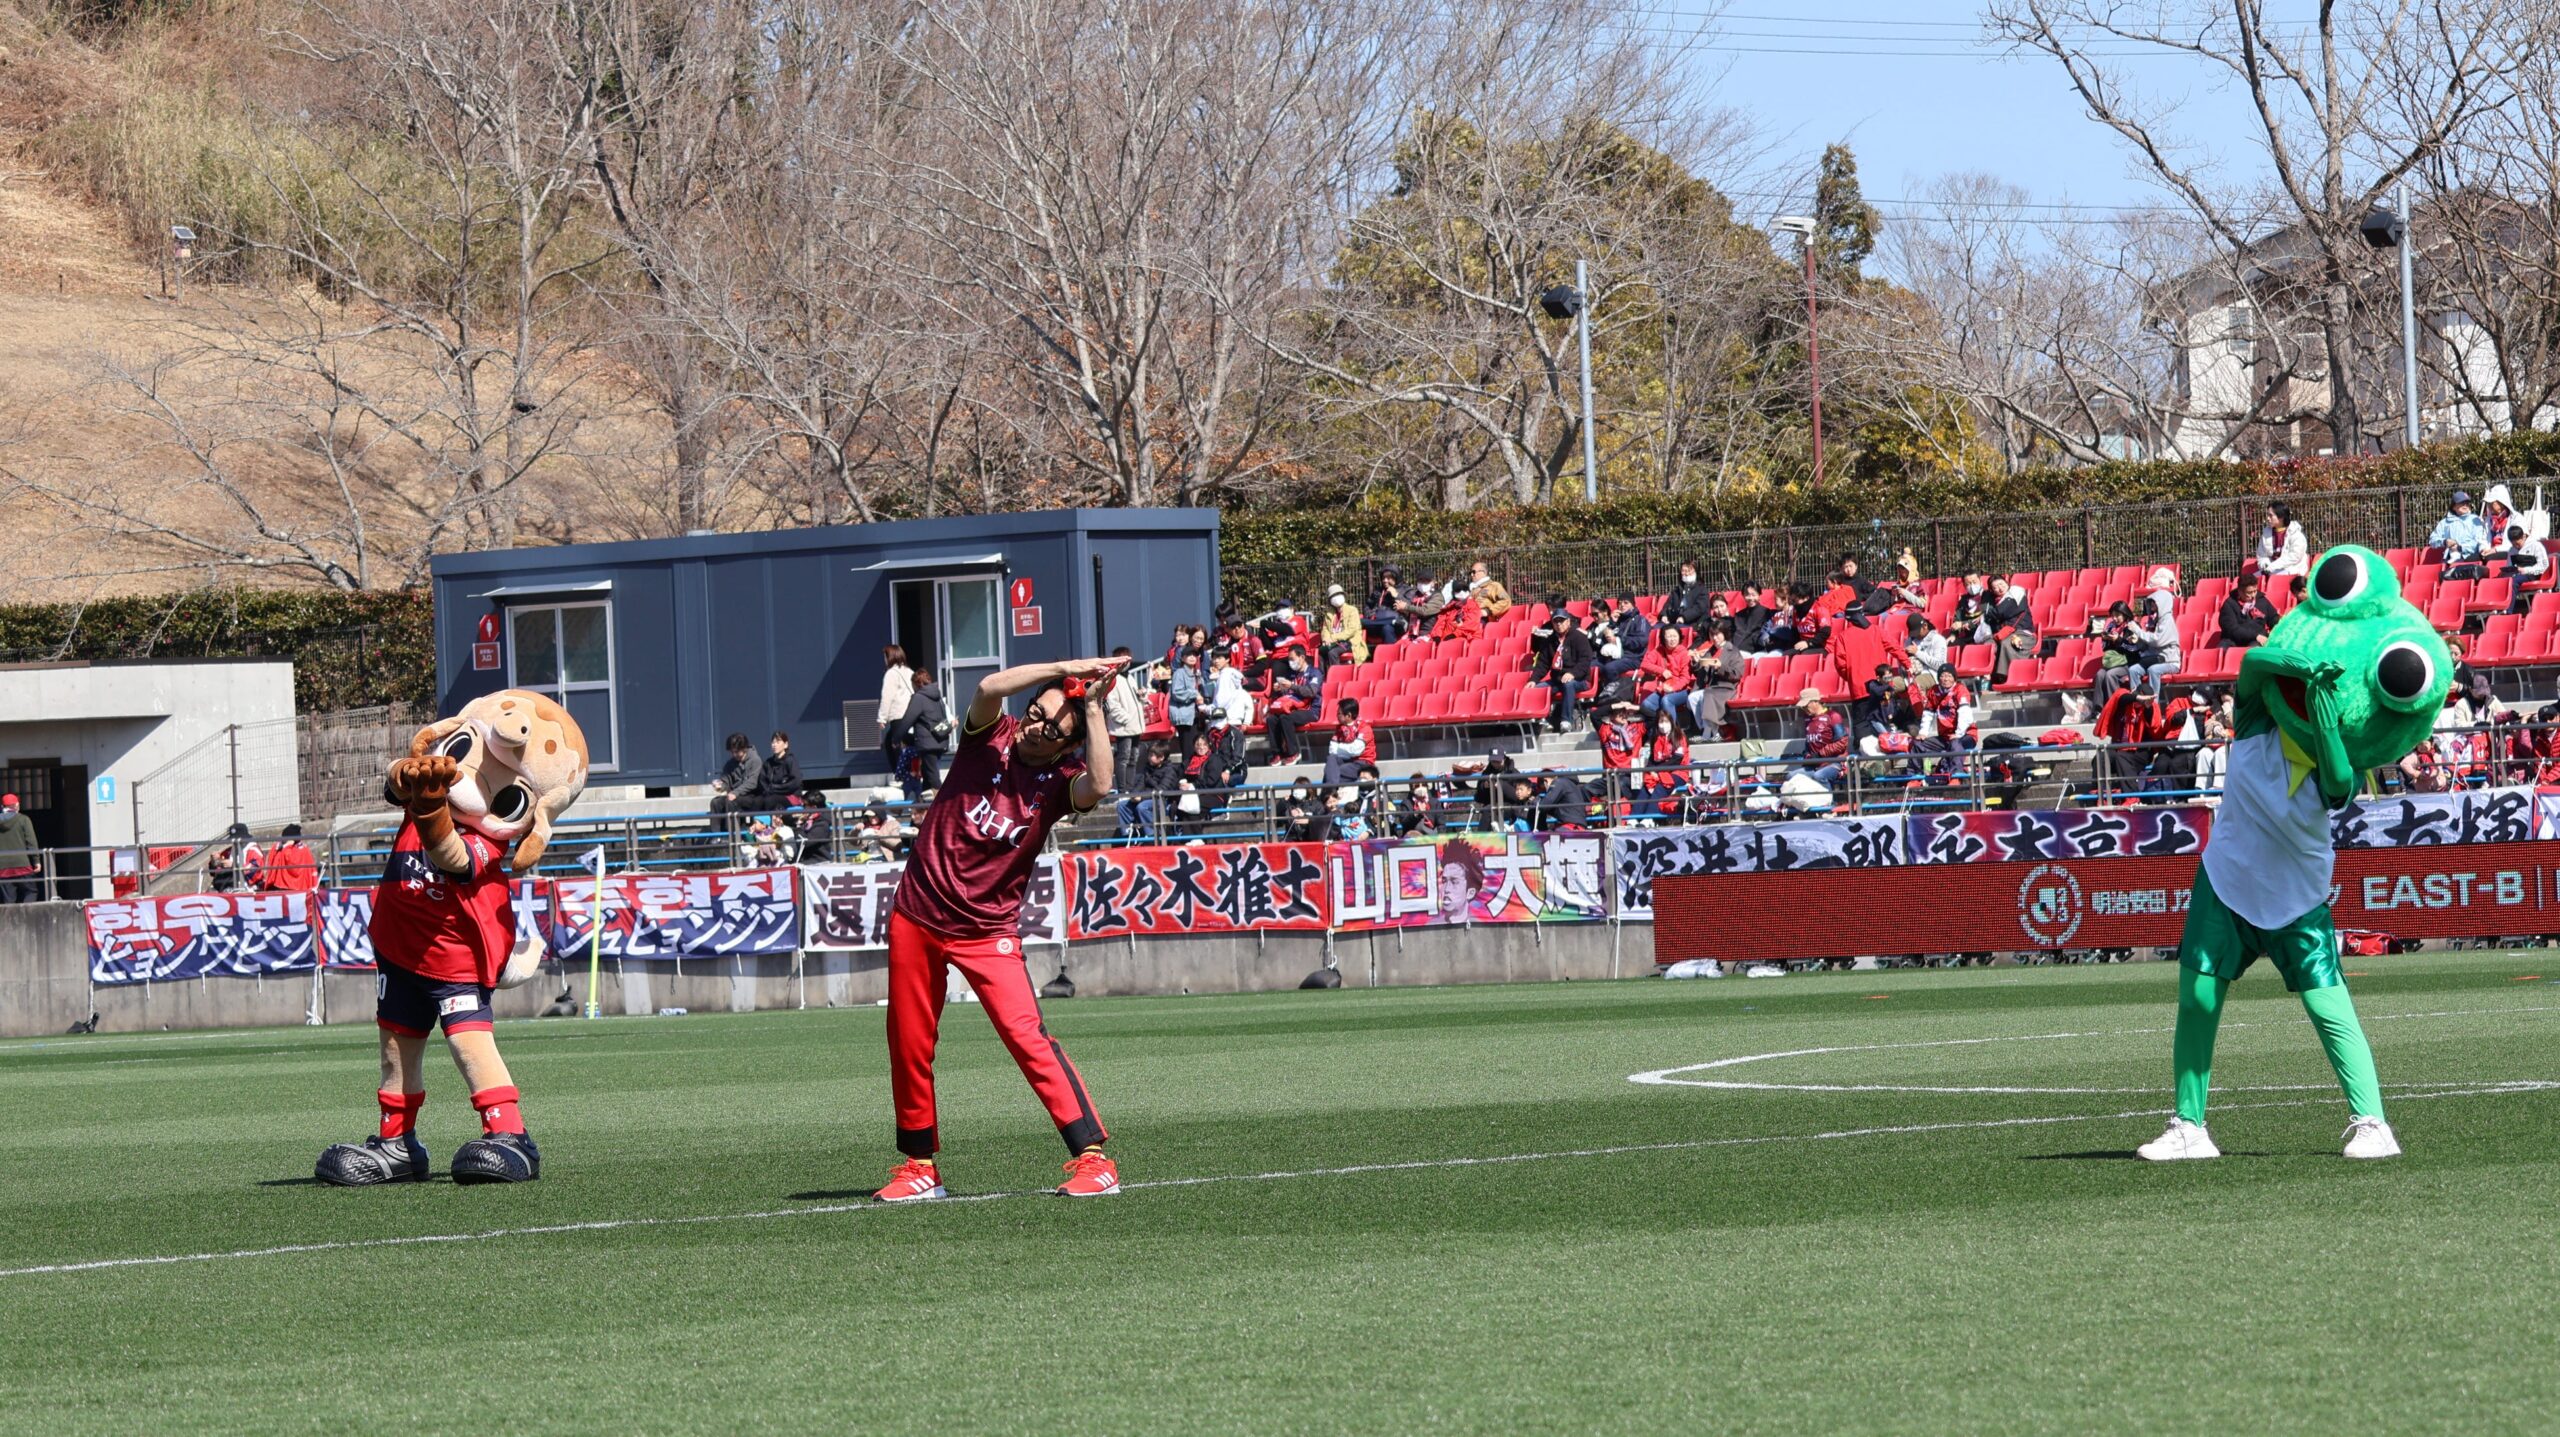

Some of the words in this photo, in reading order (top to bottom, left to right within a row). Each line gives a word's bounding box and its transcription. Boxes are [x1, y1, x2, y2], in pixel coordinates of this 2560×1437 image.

[88, 893, 308, 943] 현우빈
[1072, 847, 1322, 933] 佐々木雅士
[1331, 844, 1440, 927] 山口
[2092, 890, 2167, 915] 明治安田
[2362, 870, 2525, 911] EAST-B
